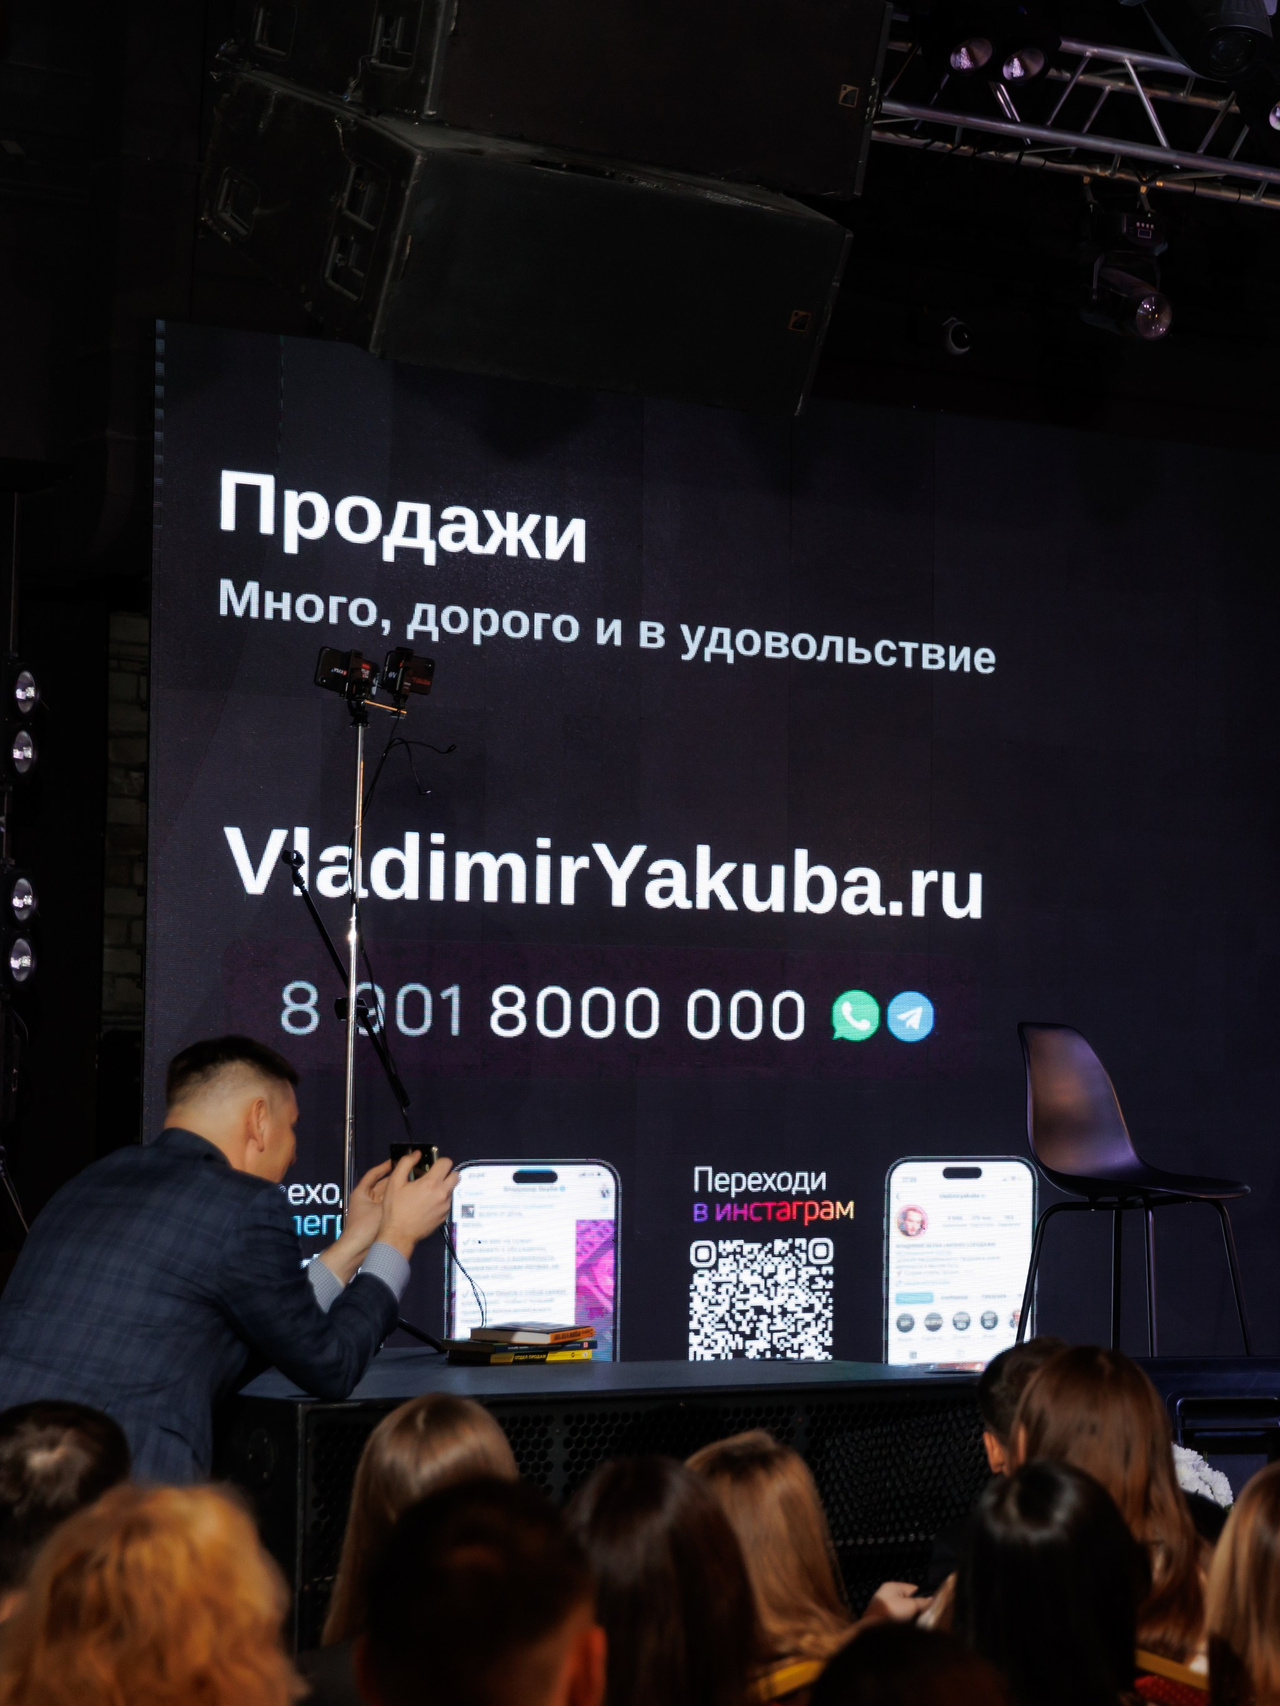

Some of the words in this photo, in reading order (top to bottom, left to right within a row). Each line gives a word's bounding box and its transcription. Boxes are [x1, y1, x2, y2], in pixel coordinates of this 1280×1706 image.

[220, 469, 587, 566] Продажи
[219, 578, 391, 636] Много,
[406, 602, 580, 646] дорого
[596, 617, 622, 647] и
[639, 620, 666, 649] в
[679, 623, 997, 675] удовольствие
[223, 826, 984, 919] VladimirYakuba.ru
[280, 980, 320, 1036] 8
[489, 984, 661, 1041] 8000
[686, 988, 806, 1042] 000
[692, 1201, 710, 1224] в
[715, 1199, 855, 1227] инстаграм
[693, 1165, 828, 1199] Переходи
